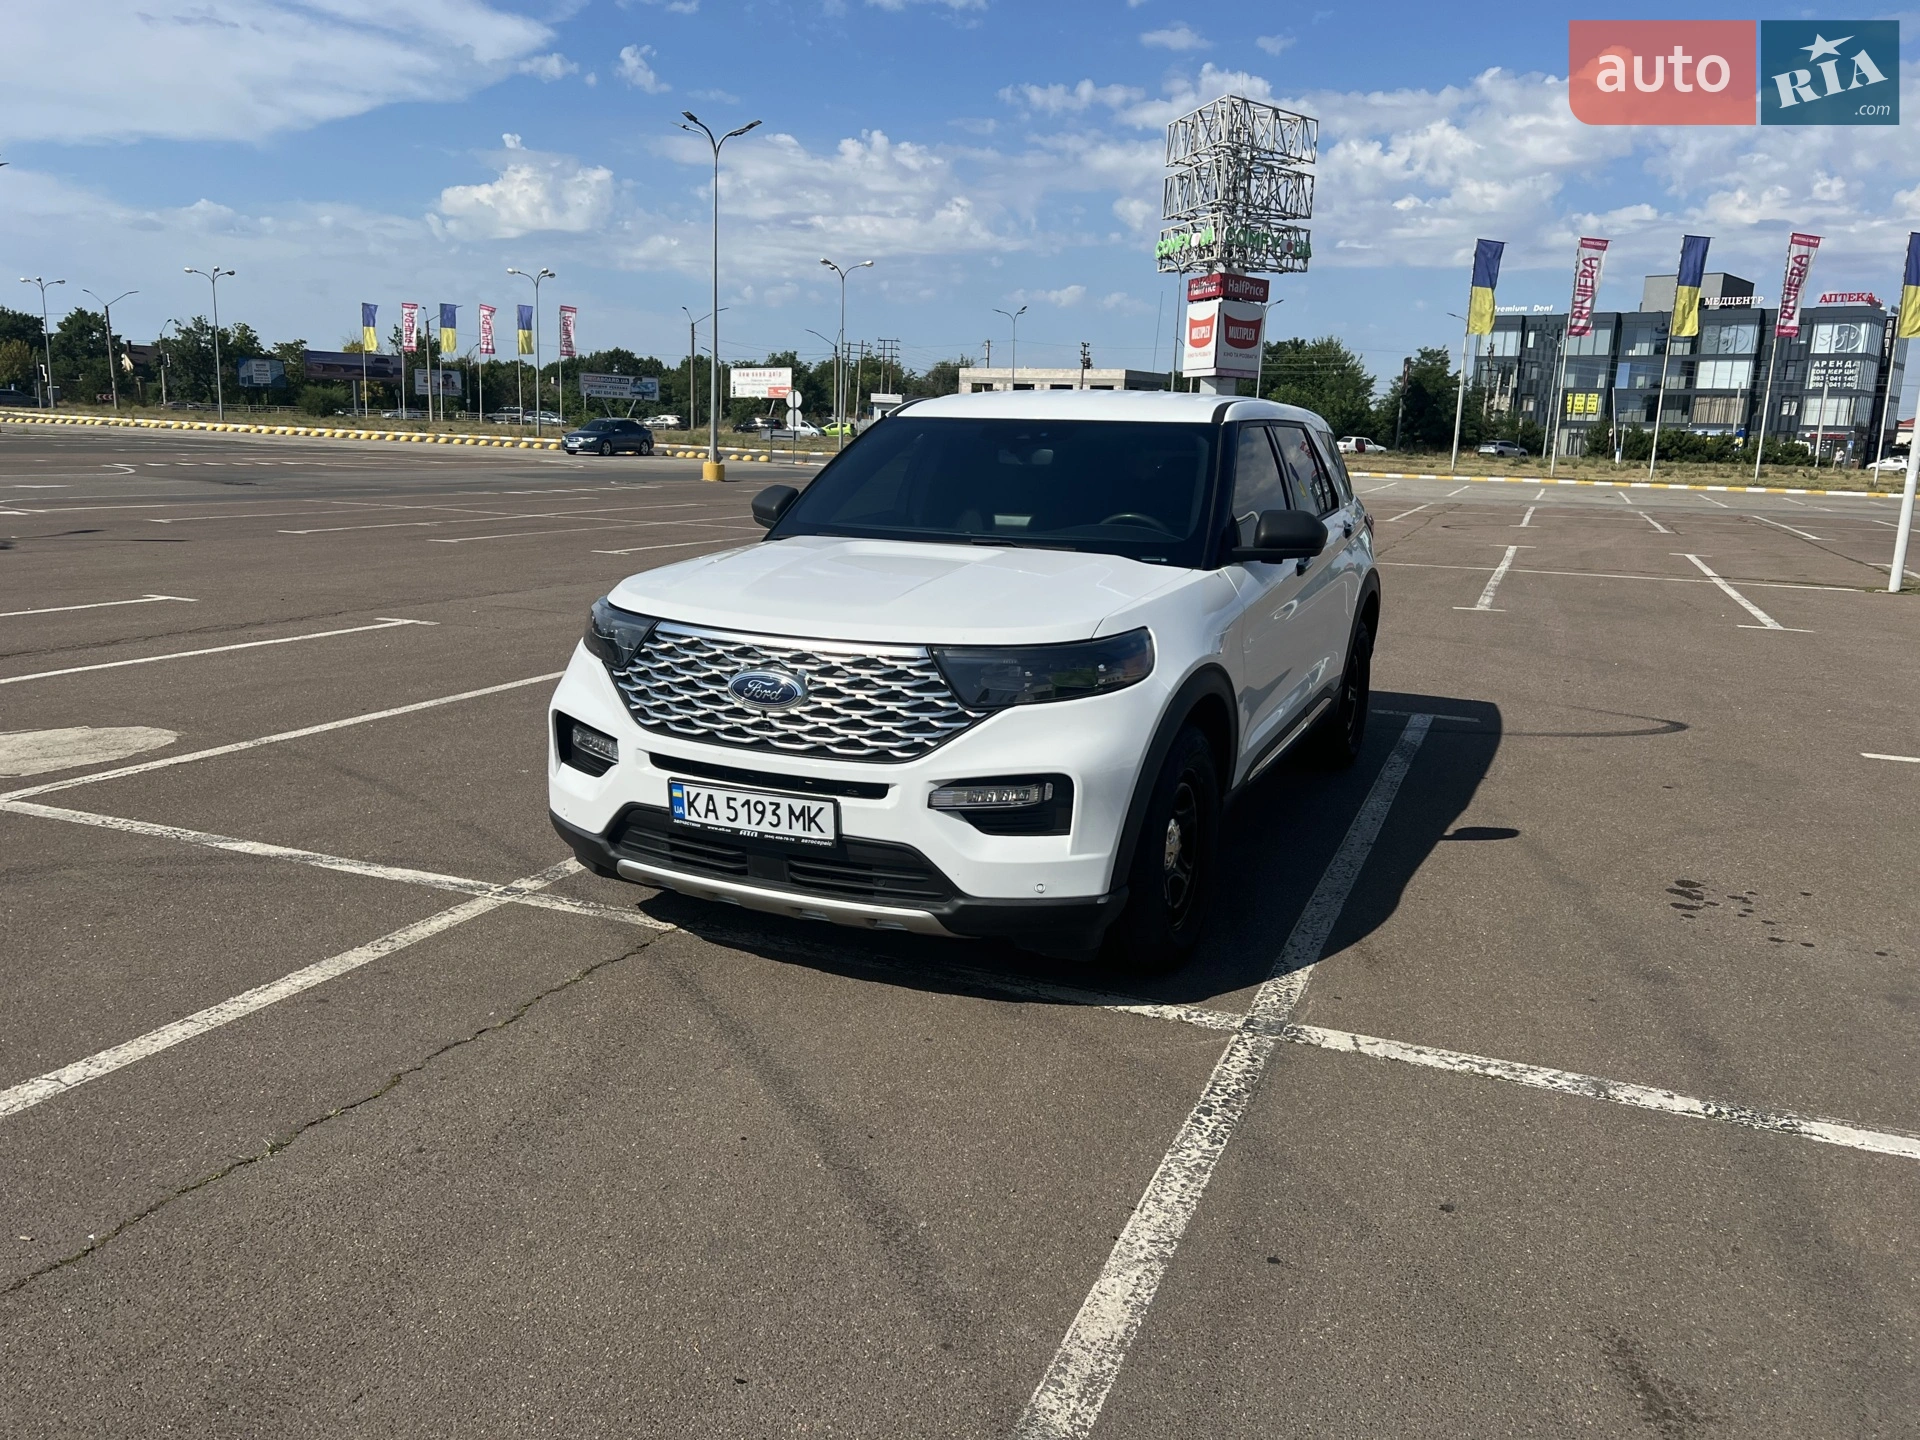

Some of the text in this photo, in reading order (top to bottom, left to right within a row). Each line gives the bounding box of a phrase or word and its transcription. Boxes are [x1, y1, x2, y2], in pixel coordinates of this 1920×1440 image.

[1228, 279, 1264, 297] HalfPrice
[1572, 257, 1599, 320] RIVIERA
[1780, 254, 1809, 320] RIVIERA
[1704, 296, 1764, 306] МЕДЦЕНТР
[1819, 292, 1876, 304] АПТЕКА
[1533, 304, 1554, 312] Dent
[1229, 326, 1256, 341] MULTIPLEX
[744, 680, 783, 701] Ford
[674, 805, 685, 815] UA
[686, 791, 825, 833] KA 5193 MK
